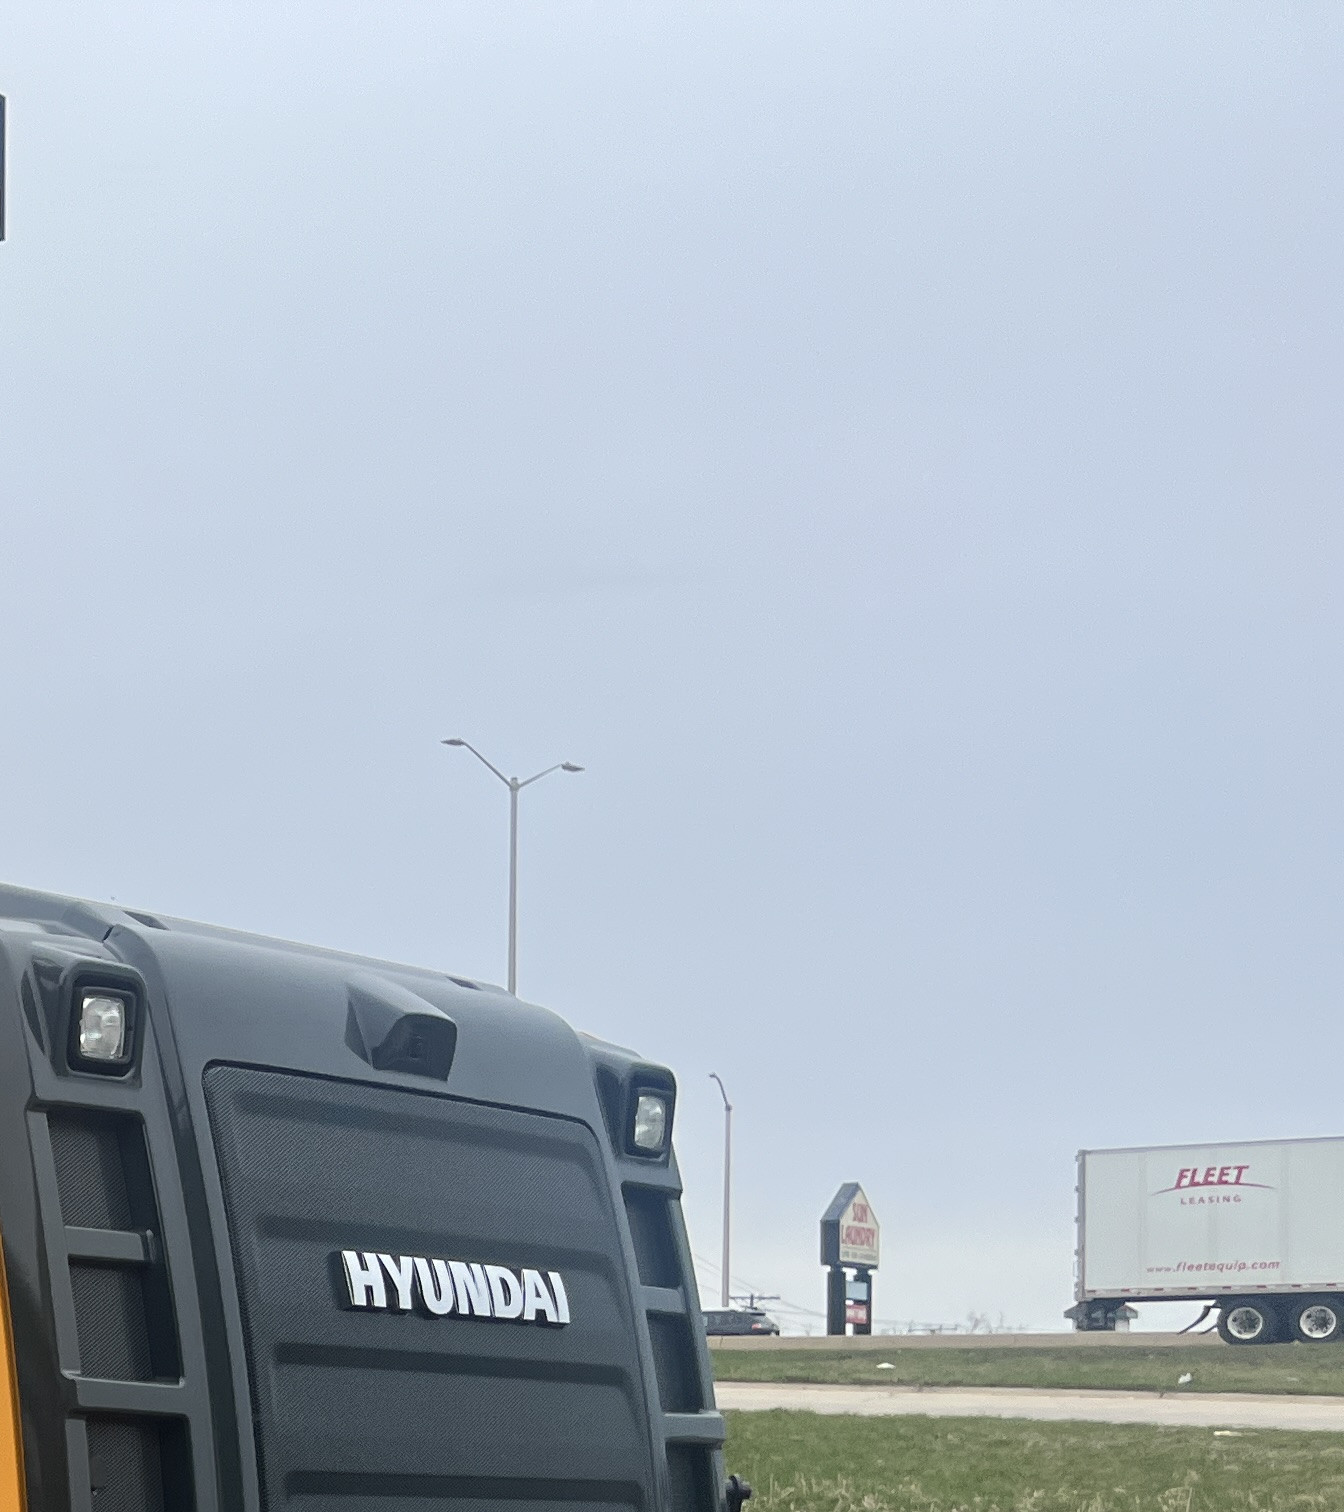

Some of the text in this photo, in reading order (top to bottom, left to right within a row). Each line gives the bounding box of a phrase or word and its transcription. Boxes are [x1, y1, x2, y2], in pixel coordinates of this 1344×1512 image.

[1175, 1165, 1250, 1190] FLEET
[1180, 1194, 1242, 1205] LEASING
[342, 1250, 570, 1324] HYUNDAI
